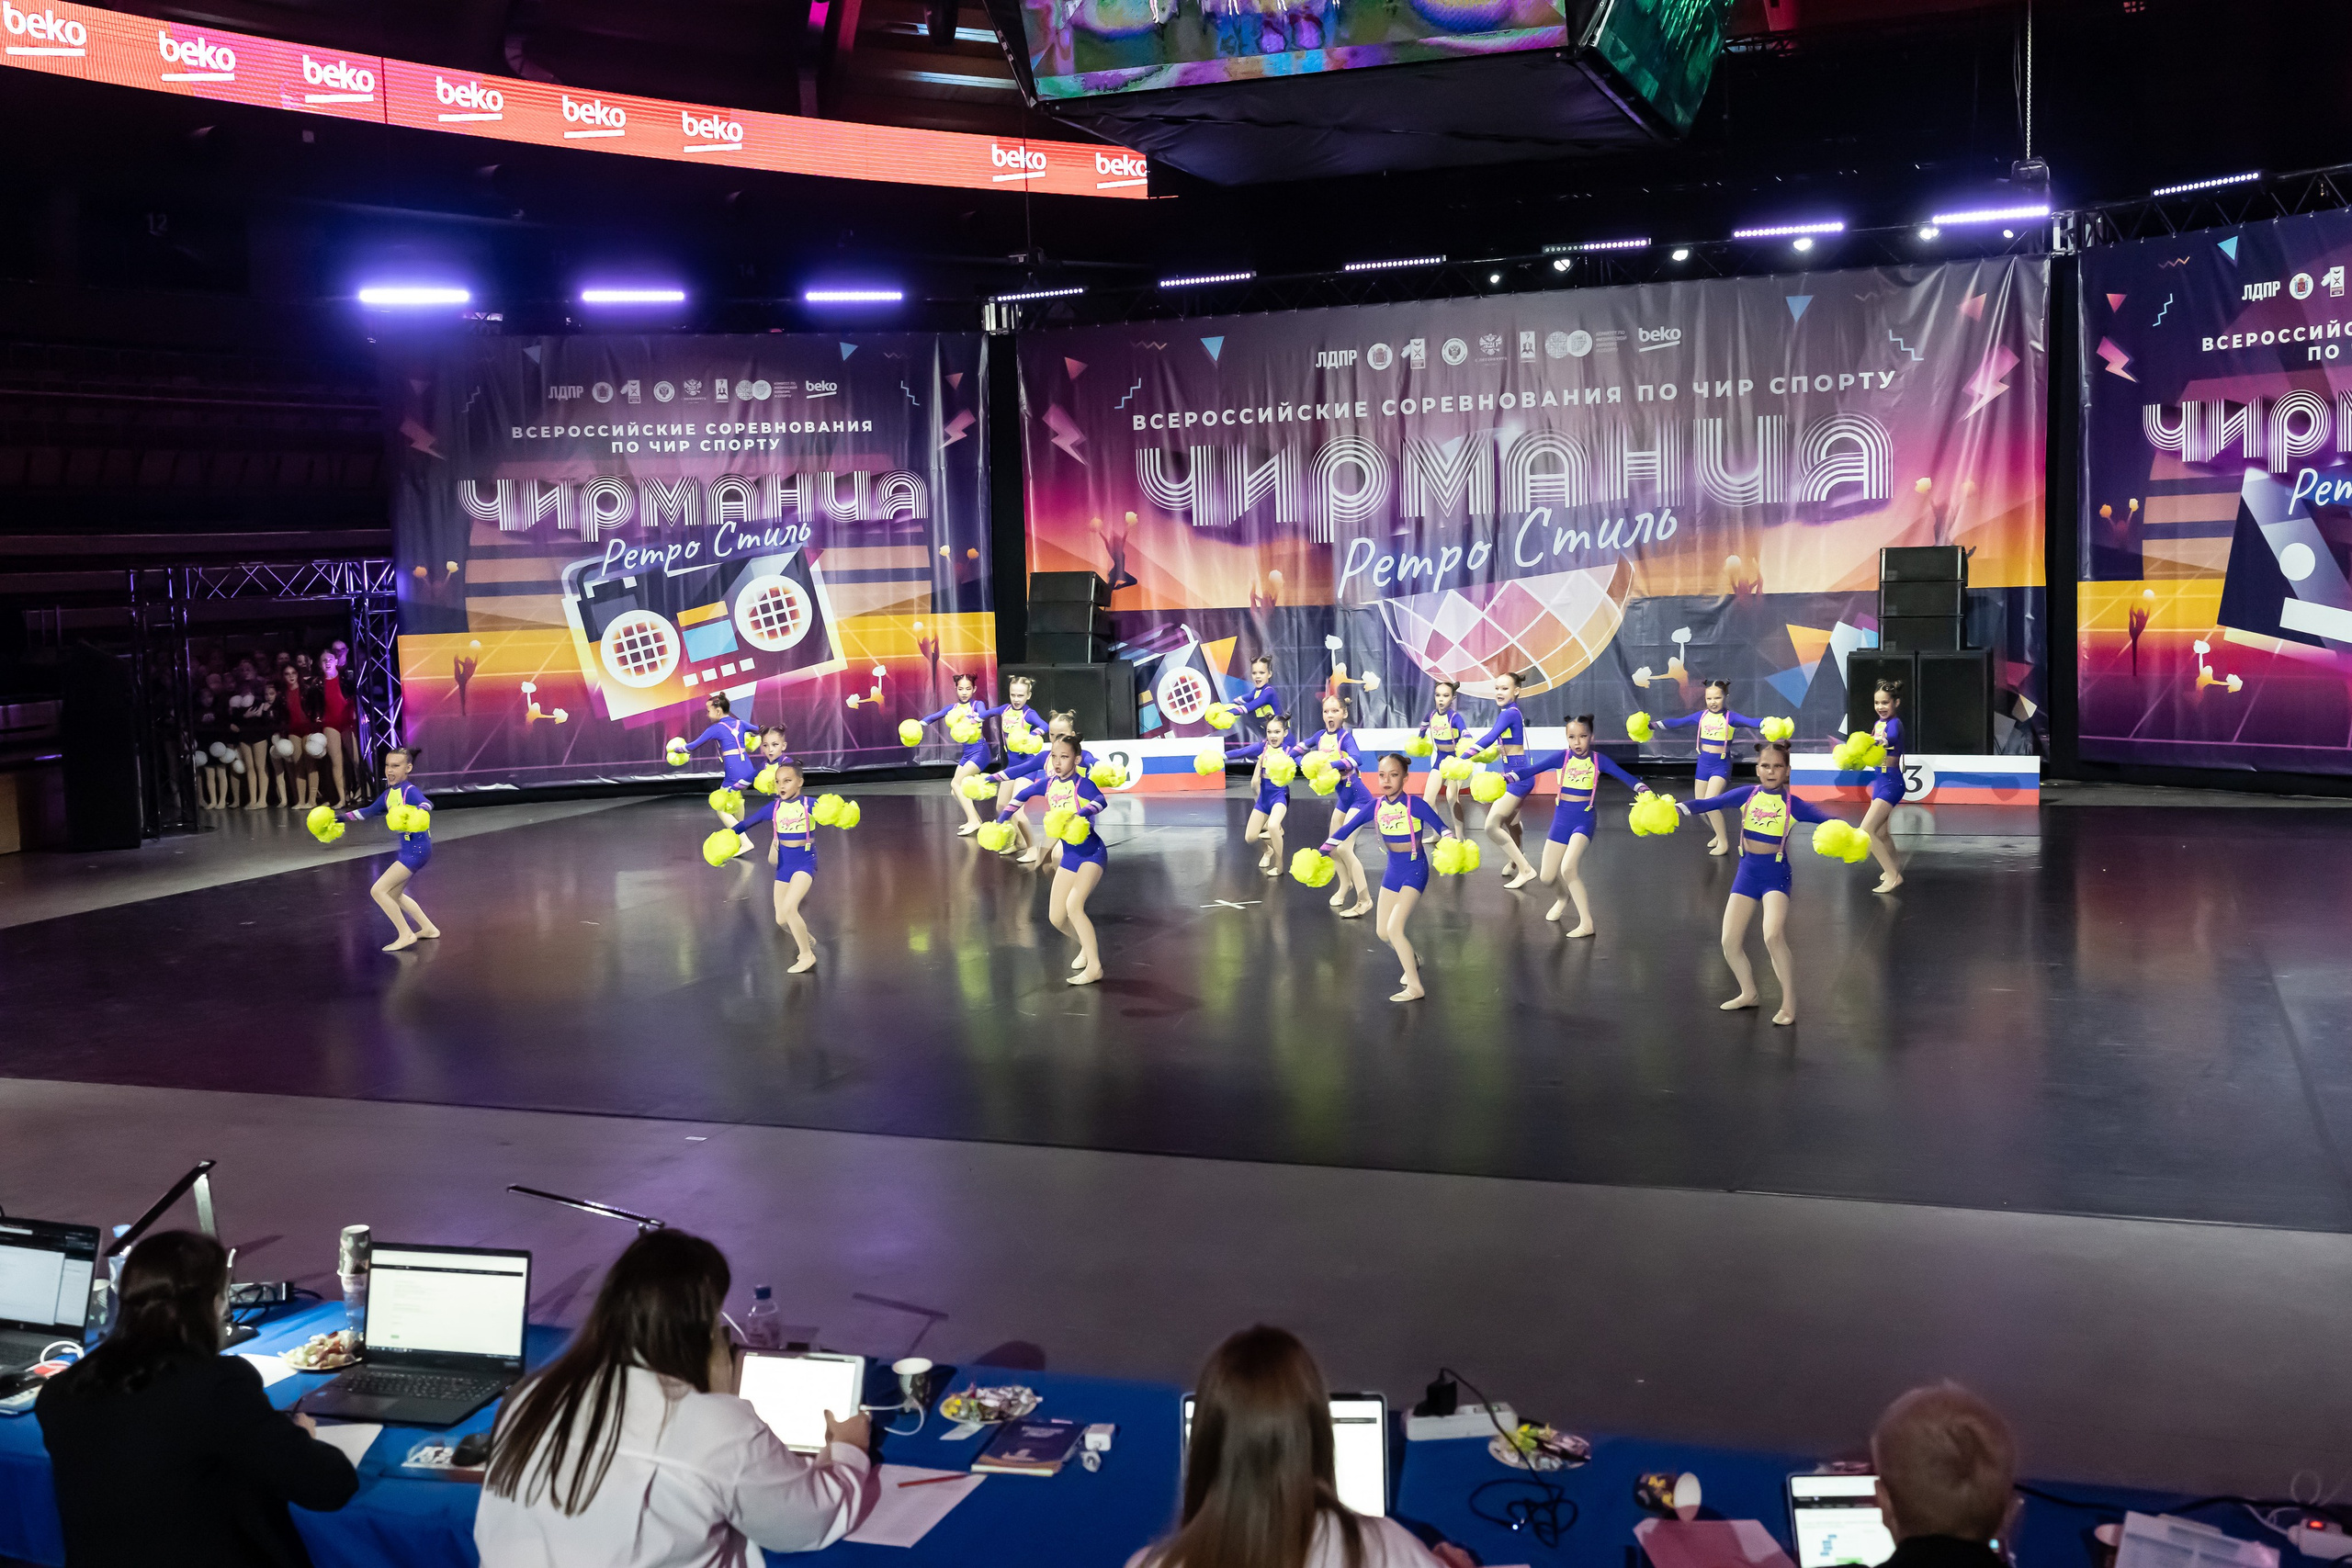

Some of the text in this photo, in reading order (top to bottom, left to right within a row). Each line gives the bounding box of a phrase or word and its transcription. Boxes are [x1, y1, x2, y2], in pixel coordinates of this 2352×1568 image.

[3, 1, 86, 46] beko
[158, 30, 236, 72] beko
[302, 54, 375, 93] beko
[435, 76, 503, 111] beko
[562, 96, 627, 129] beko
[682, 111, 743, 143] beko
[991, 144, 1046, 172] beko
[1095, 152, 1148, 177] beko
[2242, 280, 2281, 301] ЛДПР
[1638, 326, 1682, 343] beko
[1316, 349, 1357, 369] ЛДПР
[2308, 344, 2340, 361] ПО
[548, 386, 584, 401] ЛДПР
[806, 380, 838, 392] beko
[1133, 370, 1895, 431] ВСЕРОССИЙСКИЕ СОРЕВНОВАНИЯ ПО ЧИР СПОРТУ
[512, 420, 873, 438] ВСЕРОССИЙСКИЕ СОРЕВНОВАНИЯ
[2143, 389, 2352, 473] ЧИР
[612, 437, 781, 454] ПО ЧИР СПОРТУ
[601, 521, 812, 577] Ретро Стиль
[1338, 506, 1679, 599] Ретро Стиль
[1903, 765, 1923, 793] 3
